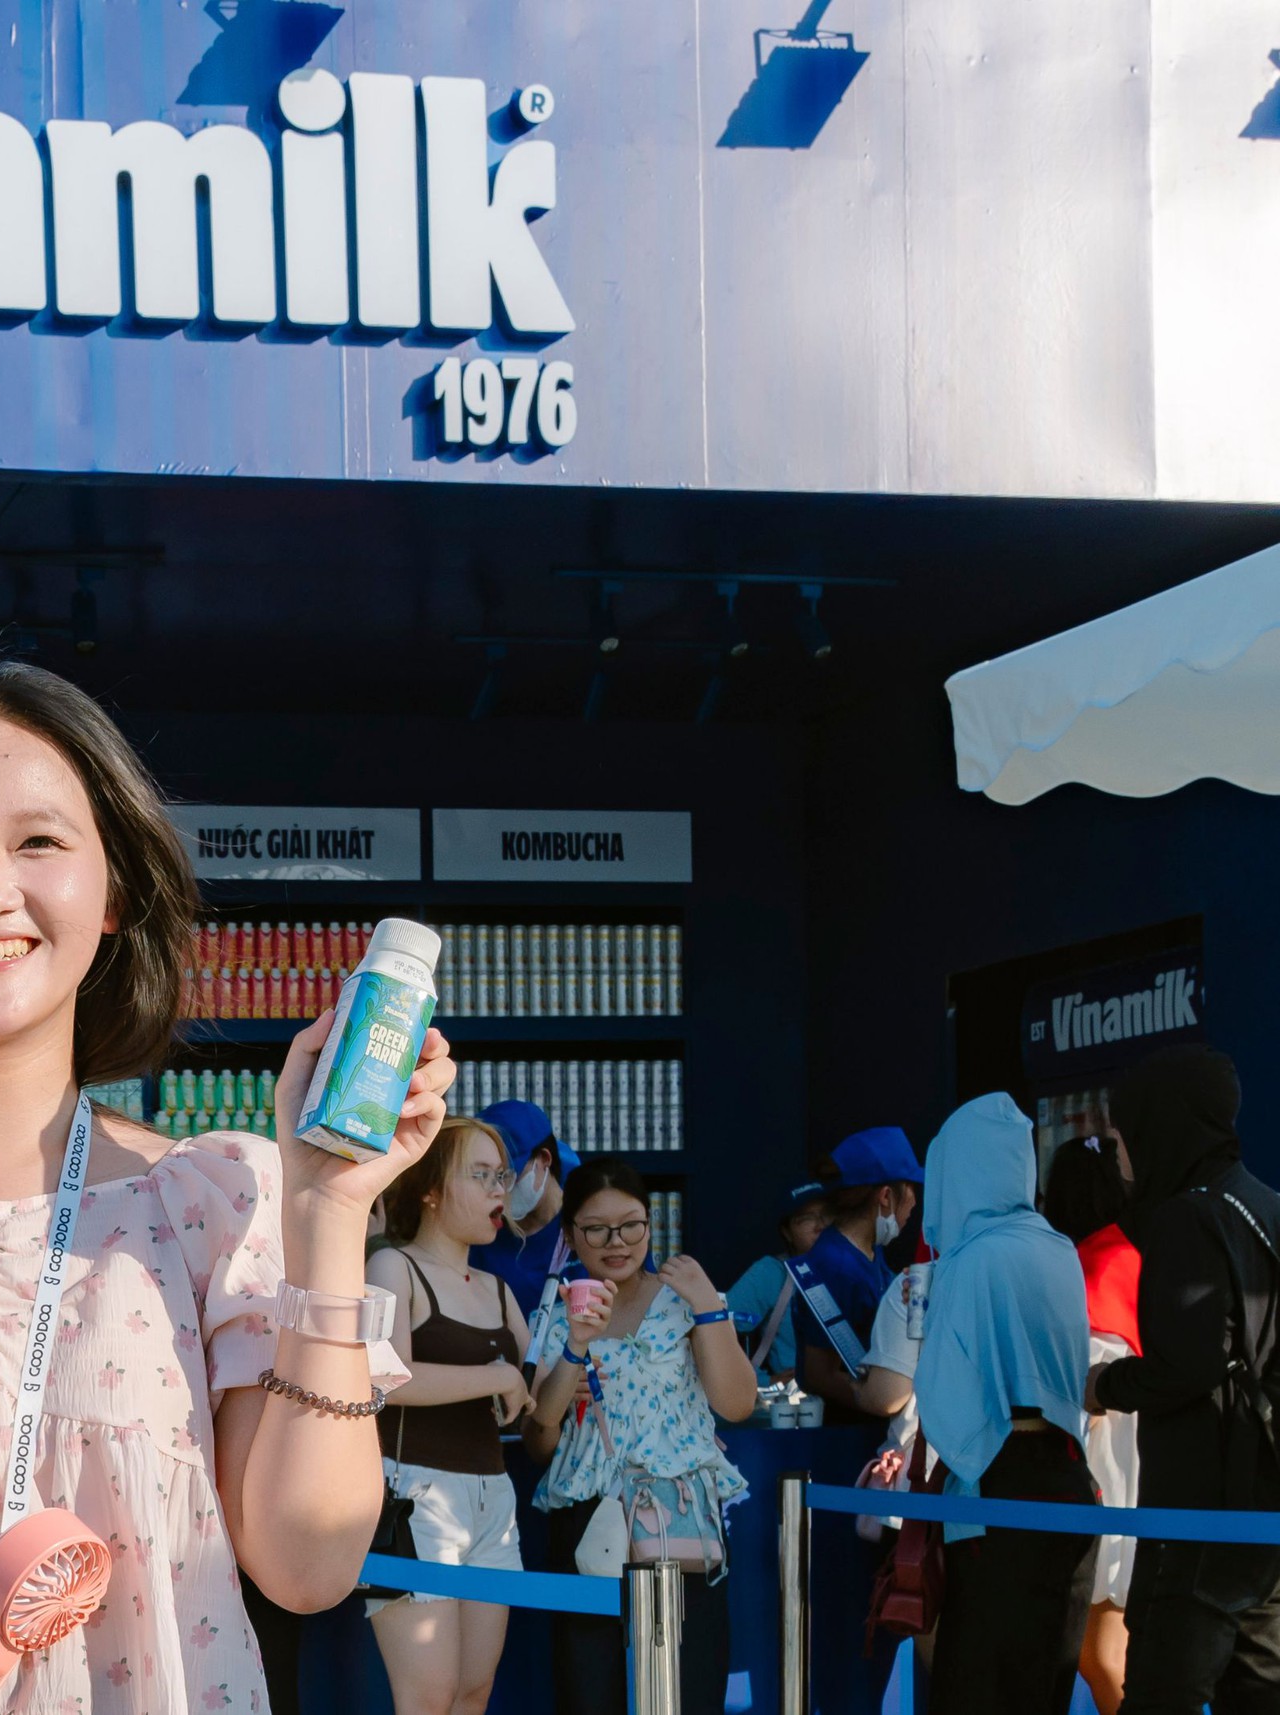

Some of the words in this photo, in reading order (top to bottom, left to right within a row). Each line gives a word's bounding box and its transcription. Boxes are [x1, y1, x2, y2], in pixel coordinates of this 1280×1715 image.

[433, 356, 578, 448] 1976
[501, 830, 625, 862] KOMBUCHA
[1030, 1020, 1046, 1042] EST
[1051, 967, 1198, 1052] Vinamilk
[369, 1022, 409, 1051] GREEN
[365, 1040, 403, 1068] FARM
